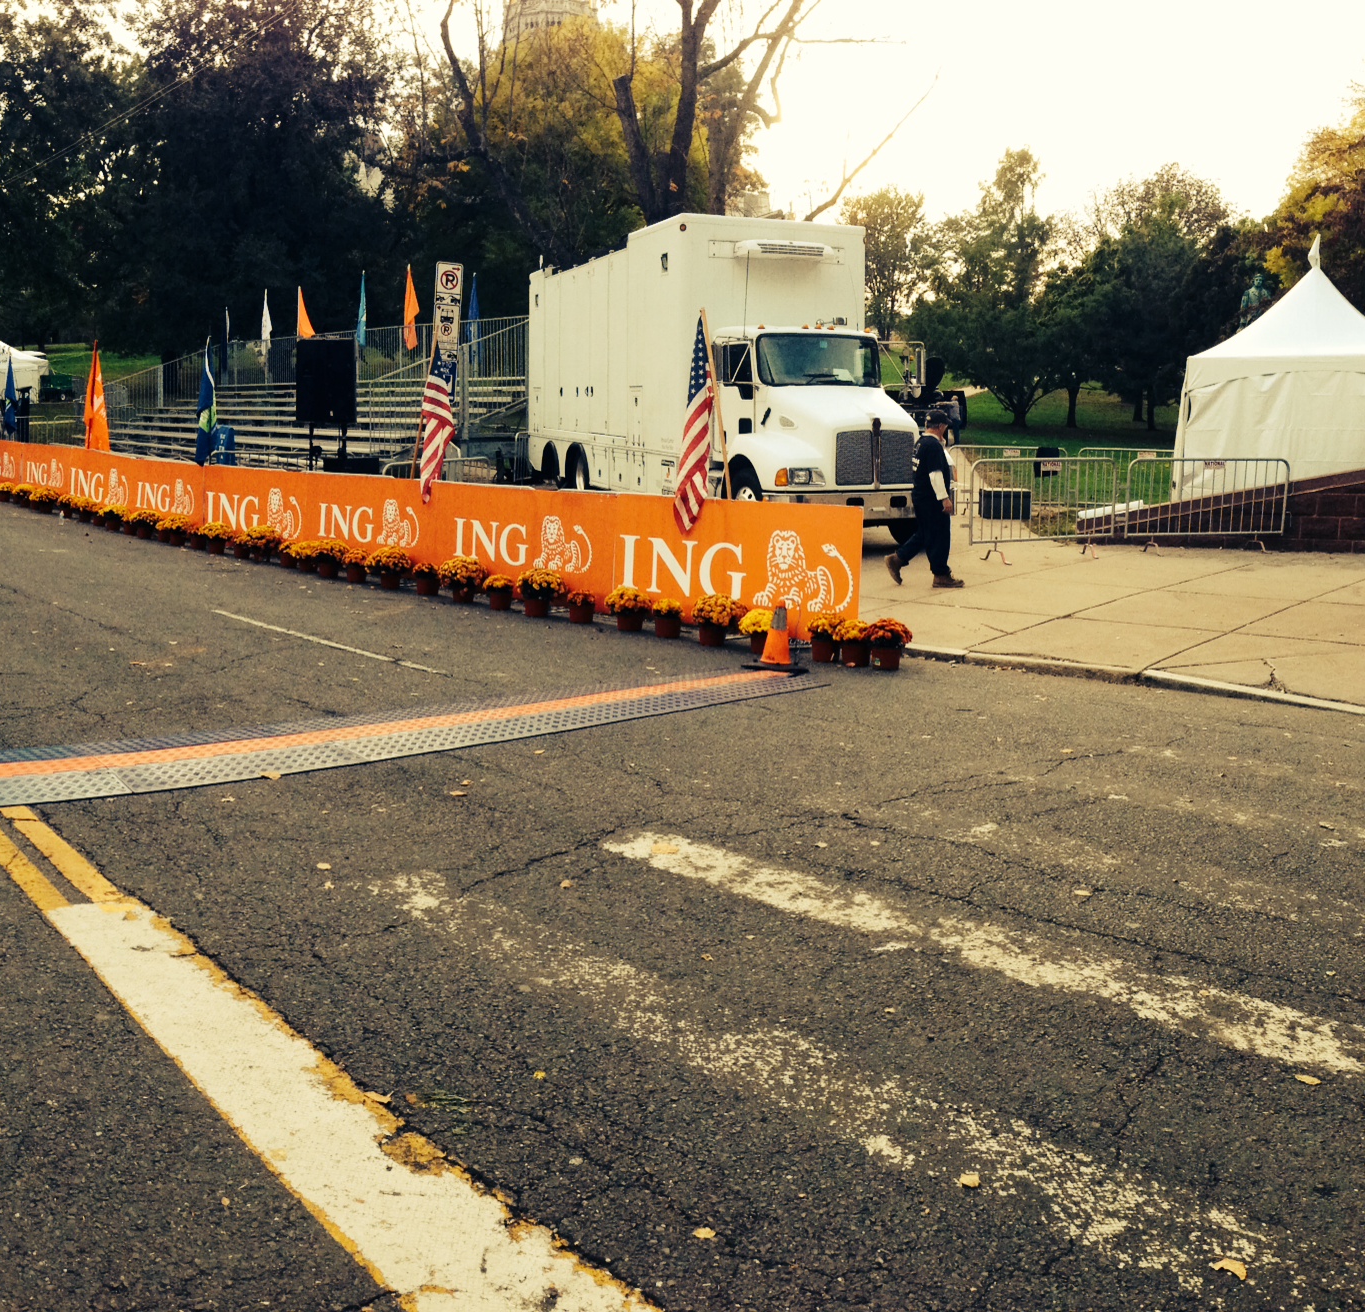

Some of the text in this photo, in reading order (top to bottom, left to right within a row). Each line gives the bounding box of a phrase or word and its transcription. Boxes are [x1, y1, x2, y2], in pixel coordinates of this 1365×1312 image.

[26, 461, 48, 486] ING
[70, 467, 104, 502] ING
[136, 481, 171, 512] ING
[206, 491, 260, 531] ING
[318, 503, 374, 543] ING
[454, 518, 528, 566] ING
[619, 535, 747, 600] ING
